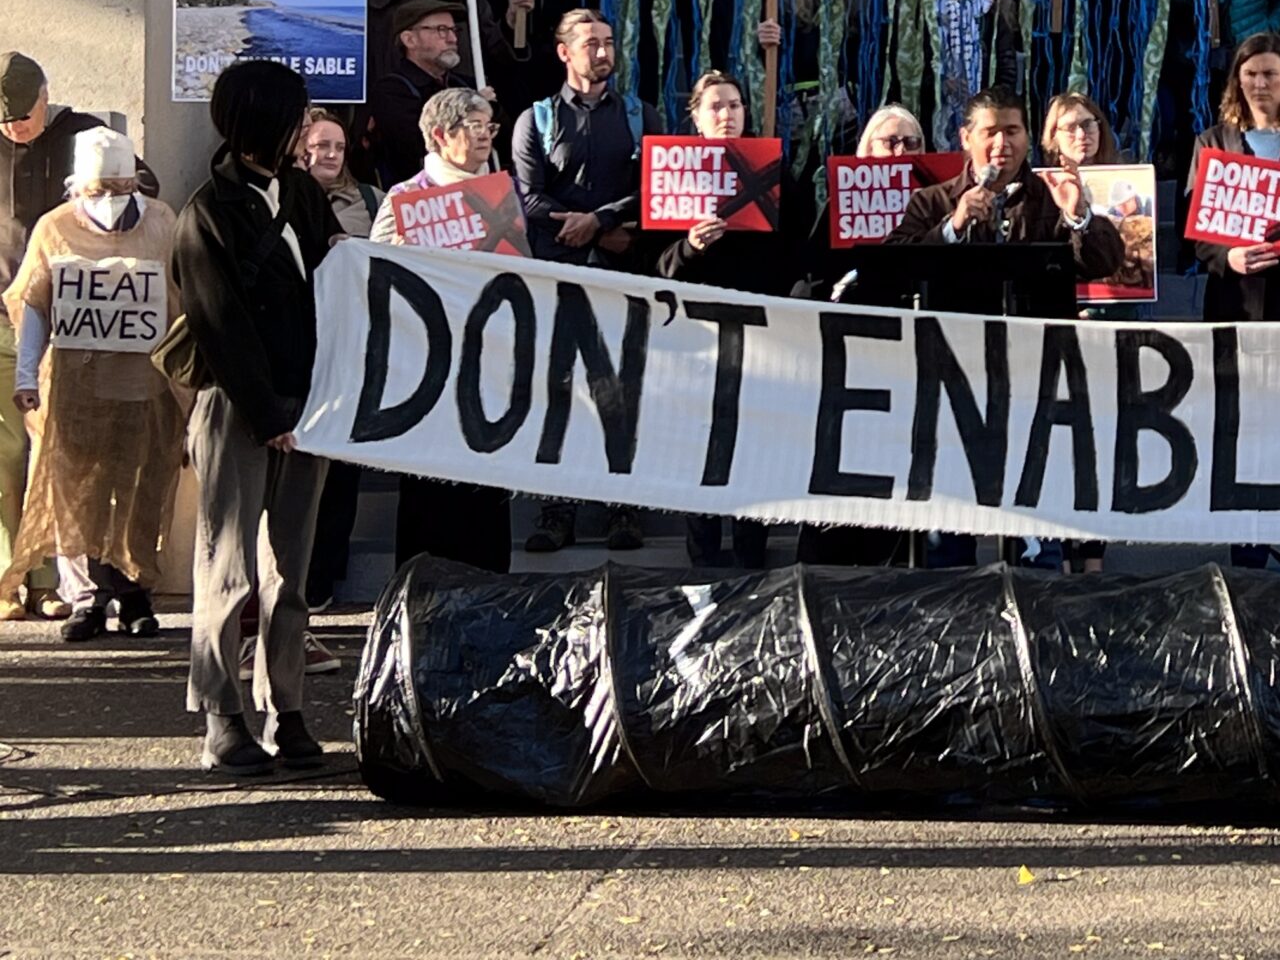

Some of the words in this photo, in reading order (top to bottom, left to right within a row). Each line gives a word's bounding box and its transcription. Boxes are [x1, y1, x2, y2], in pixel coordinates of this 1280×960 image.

[304, 56, 356, 75] SABLE
[651, 145, 726, 170] DON'T
[650, 170, 738, 196] ENABLE
[837, 164, 913, 190] DON'T
[400, 191, 465, 228] DON'T
[650, 196, 718, 220] SABLE
[1195, 208, 1268, 242] SABLE
[404, 213, 487, 248] ENABLE
[58, 267, 158, 302] HEAT
[52, 306, 158, 341] WAVES
[350, 256, 768, 487] DON'T
